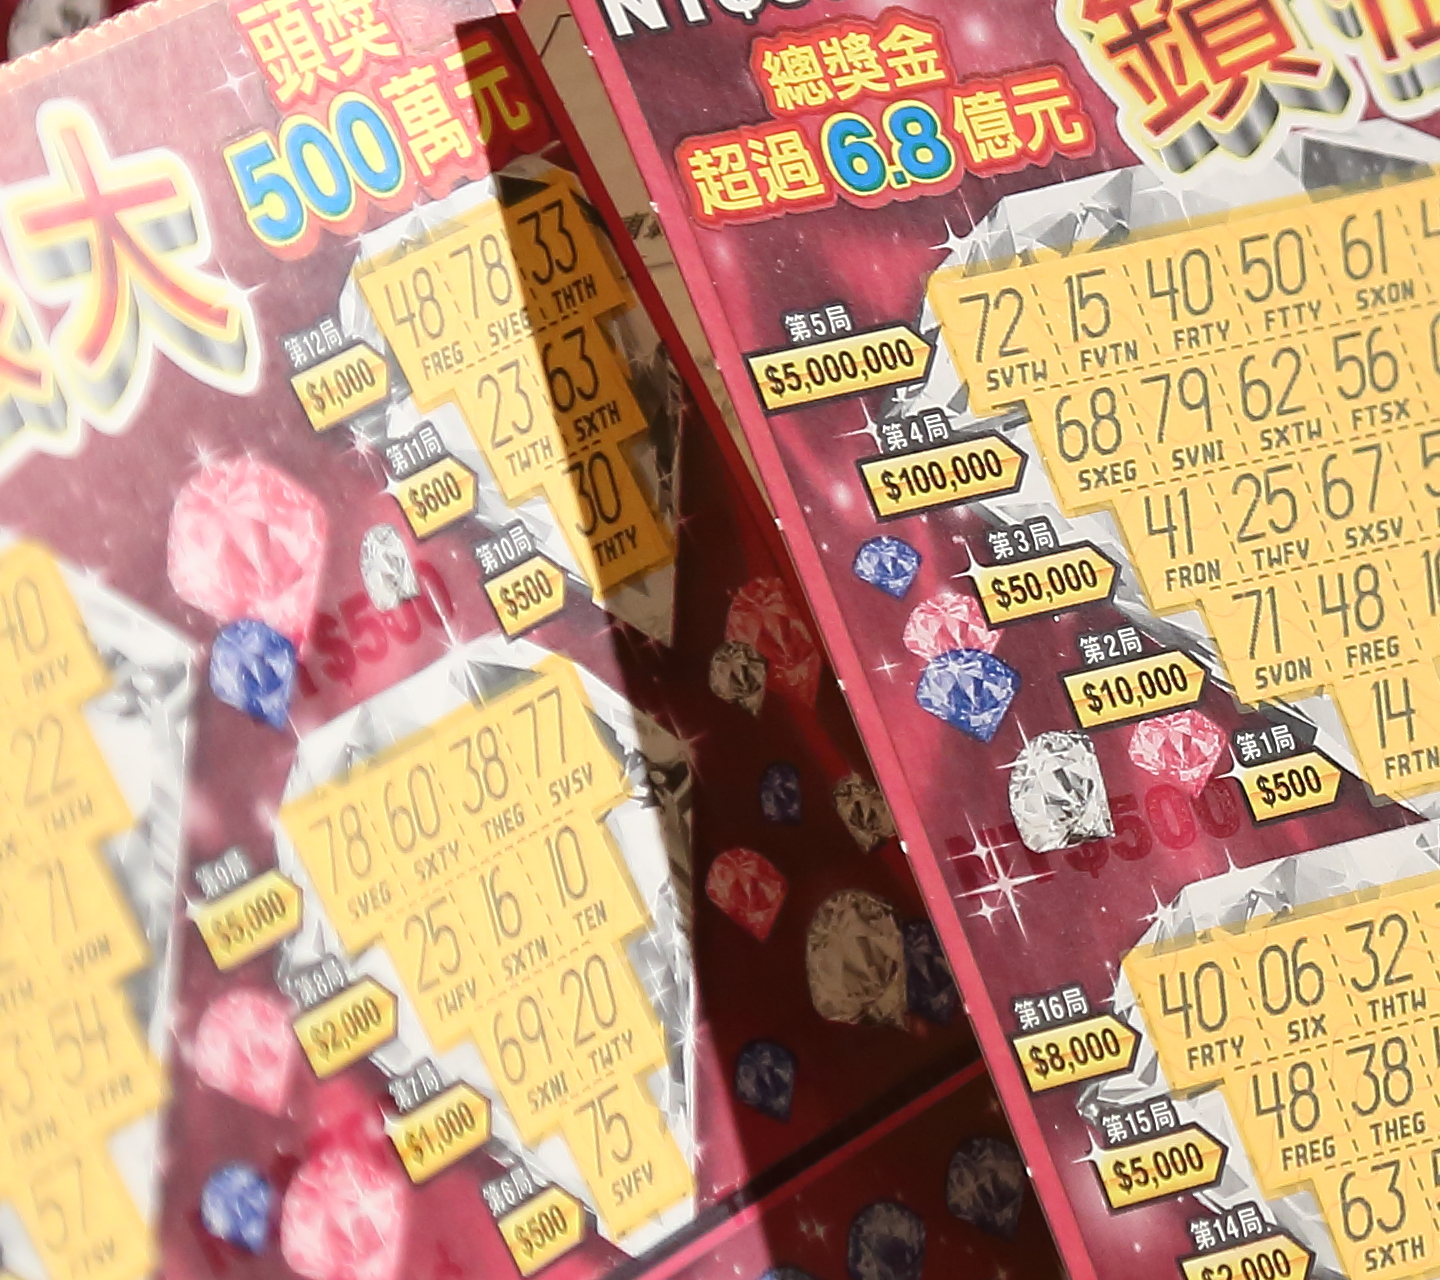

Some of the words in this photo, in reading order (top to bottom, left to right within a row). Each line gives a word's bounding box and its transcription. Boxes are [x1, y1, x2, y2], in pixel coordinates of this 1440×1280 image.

[760, 21, 947, 112] 總獎金
[226, 40, 532, 246] 500萬元
[687, 77, 1087, 217] 超過6.8億元
[383, 267, 445, 350] 48
[450, 233, 515, 319] 78
[516, 200, 579, 287] 33
[959, 288, 1028, 364] 72
[1064, 268, 1112, 343] 15
[1146, 247, 1215, 323] 40
[1239, 228, 1307, 304] 50
[1340, 209, 1388, 281] 61
[283, 320, 346, 369] 第12局
[784, 304, 853, 342] 第5局
[1079, 340, 1140, 373] FVTN
[1173, 320, 1232, 351] FRTY
[1264, 299, 1322, 333] FTTY
[305, 358, 377, 414] $1,000
[476, 359, 535, 450] 23
[542, 327, 601, 414] 63
[764, 338, 915, 398] $5,000,000
[1055, 386, 1123, 463] 68
[1140, 366, 1215, 445] 79
[1238, 346, 1307, 422] 62
[1334, 328, 1399, 401] 56
[880, 412, 950, 453] 第4局
[1078, 459, 1138, 493] SXEG
[1171, 440, 1226, 471] SVNI
[1351, 398, 1412, 431] FTSX
[408, 475, 462, 521] $600
[565, 450, 623, 537] 30
[880, 447, 1004, 504] $100,000
[1144, 486, 1195, 560] 41
[1231, 463, 1299, 544] 25
[1320, 442, 1384, 521] 67
[987, 521, 1056, 561] 第3局
[1251, 538, 1311, 572] TWFV
[1344, 516, 1405, 550] SXSV
[990, 559, 1098, 610] $50,000
[1231, 586, 1281, 660] 71
[1317, 562, 1385, 638] 48
[1078, 626, 1144, 666] 第2局
[1082, 663, 1189, 715] $10,000
[1370, 674, 1417, 751] 14
[381, 761, 441, 854] 60
[449, 726, 509, 816] 38
[510, 684, 571, 781] 77
[1234, 722, 1298, 762] 第1局
[1256, 764, 1323, 812] $500
[1158, 959, 1230, 1040] 40
[1258, 936, 1327, 1016] 06
[1344, 913, 1413, 994] 32
[1012, 986, 1089, 1030] 第16局
[1027, 1026, 1123, 1080] $8,000
[1186, 1035, 1246, 1072] FRTY
[1285, 1014, 1329, 1044] SIX
[1251, 1060, 1321, 1141] 48
[1345, 1035, 1416, 1118] 38
[1100, 1101, 1177, 1146] 第15局
[1111, 1142, 1206, 1196] $5,000
[1339, 1159, 1408, 1245] 63
